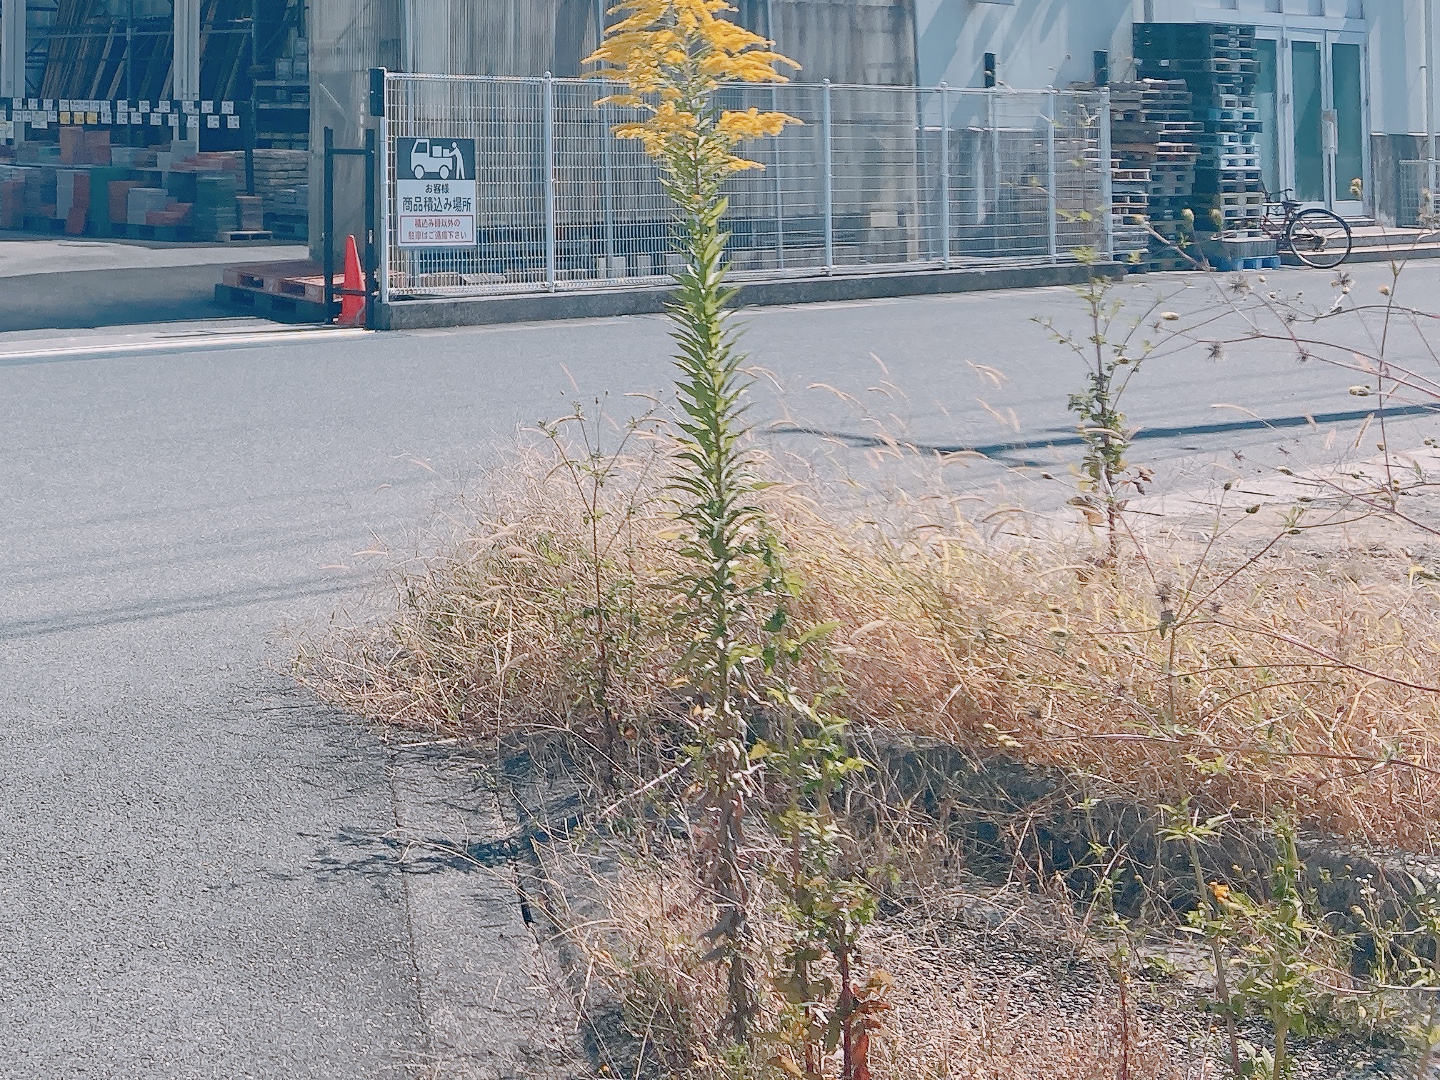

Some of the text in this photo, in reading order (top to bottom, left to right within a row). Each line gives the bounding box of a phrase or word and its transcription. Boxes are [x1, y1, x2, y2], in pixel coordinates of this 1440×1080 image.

[425, 183, 450, 194] お客様
[402, 197, 472, 213] 商品積込み場所
